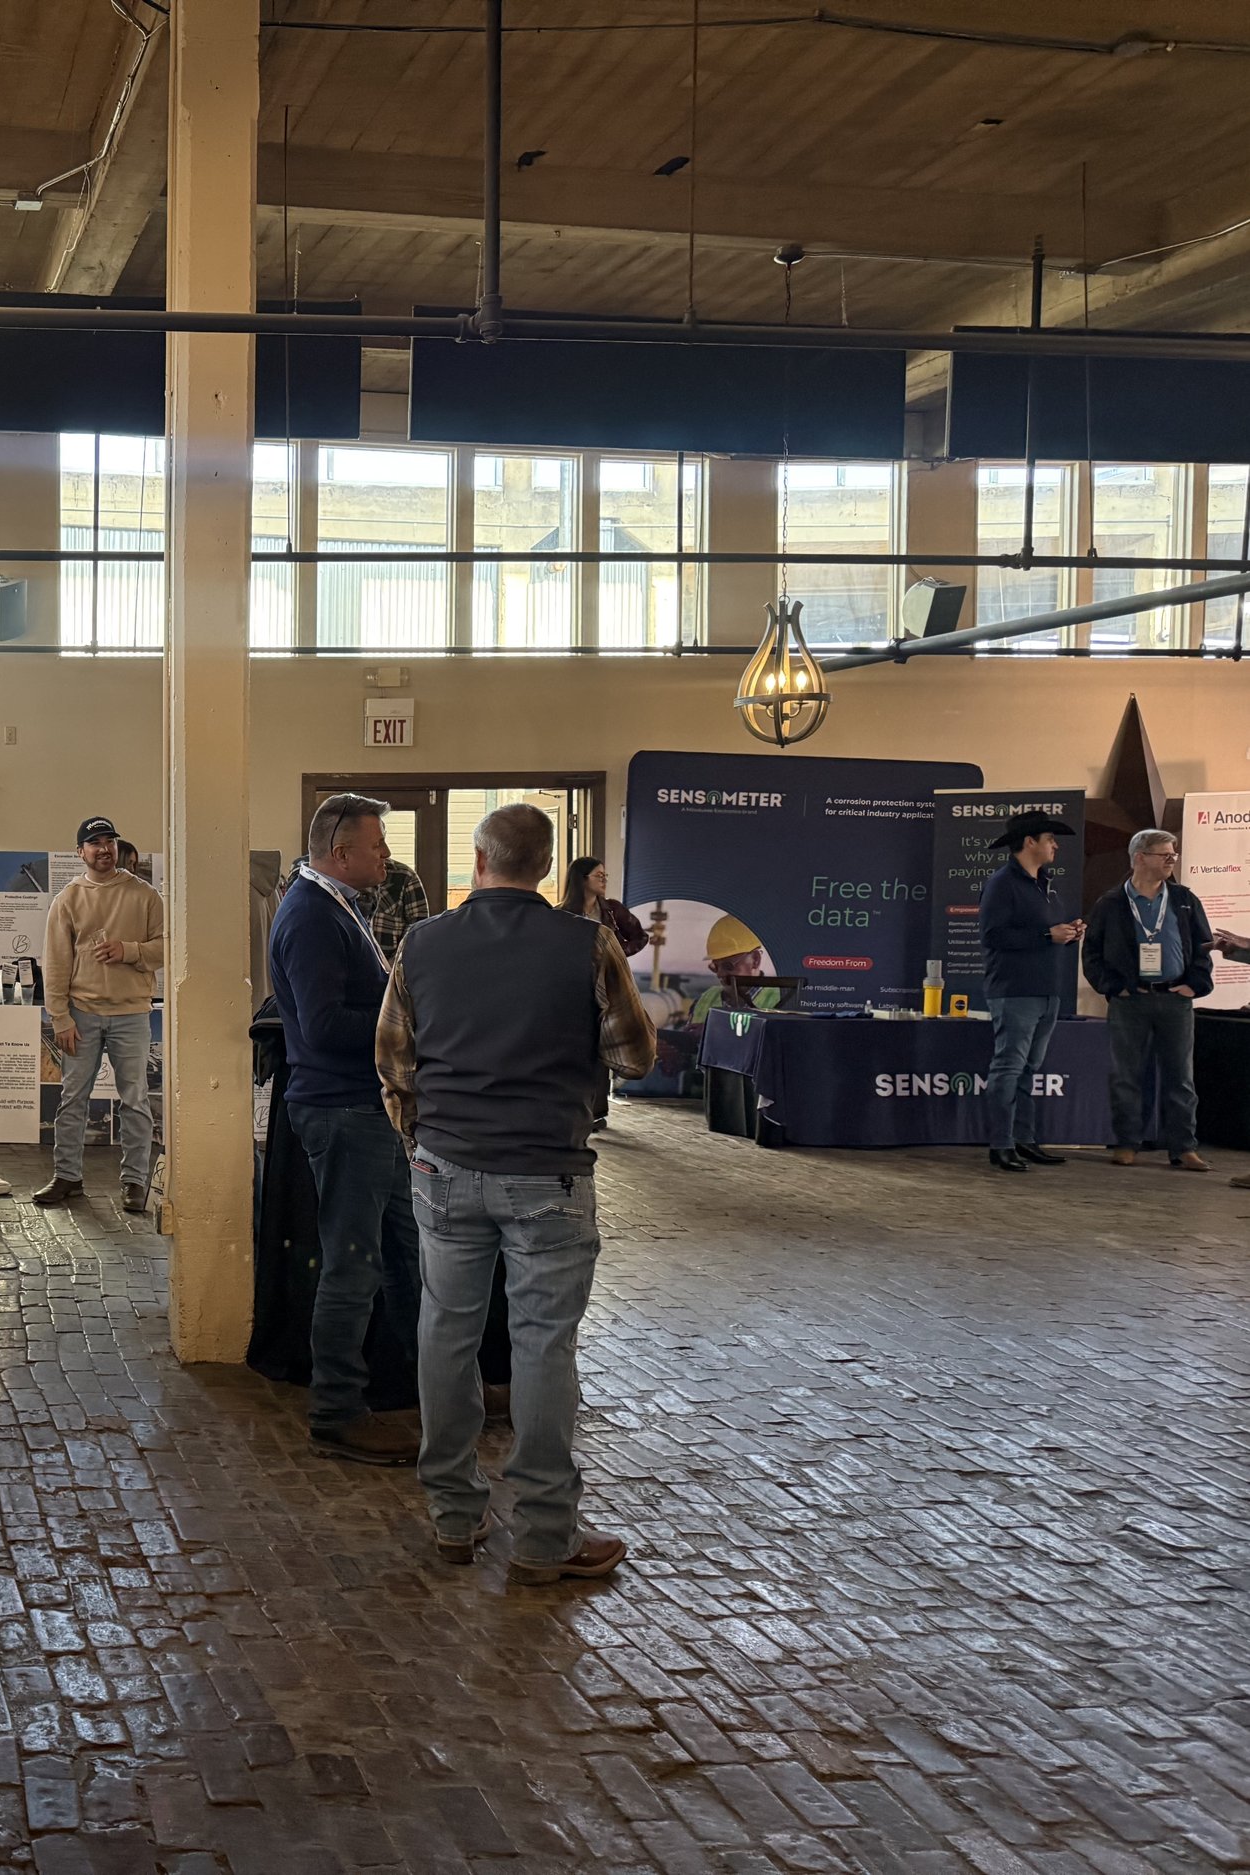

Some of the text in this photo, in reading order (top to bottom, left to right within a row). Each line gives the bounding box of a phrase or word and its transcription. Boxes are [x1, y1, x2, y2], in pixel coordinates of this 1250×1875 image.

[373, 719, 407, 744] EXIT
[872, 799, 915, 807] protection
[838, 808, 866, 816] critical
[866, 809, 901, 819] industry
[961, 836, 981, 847] It's
[964, 851, 994, 863] why
[1200, 864, 1242, 874] Verticalflex
[812, 876, 927, 900] Free the
[809, 958, 867, 967] Freedom From
[814, 984, 855, 992] middle-man
[800, 1000, 836, 1009] Third-party
